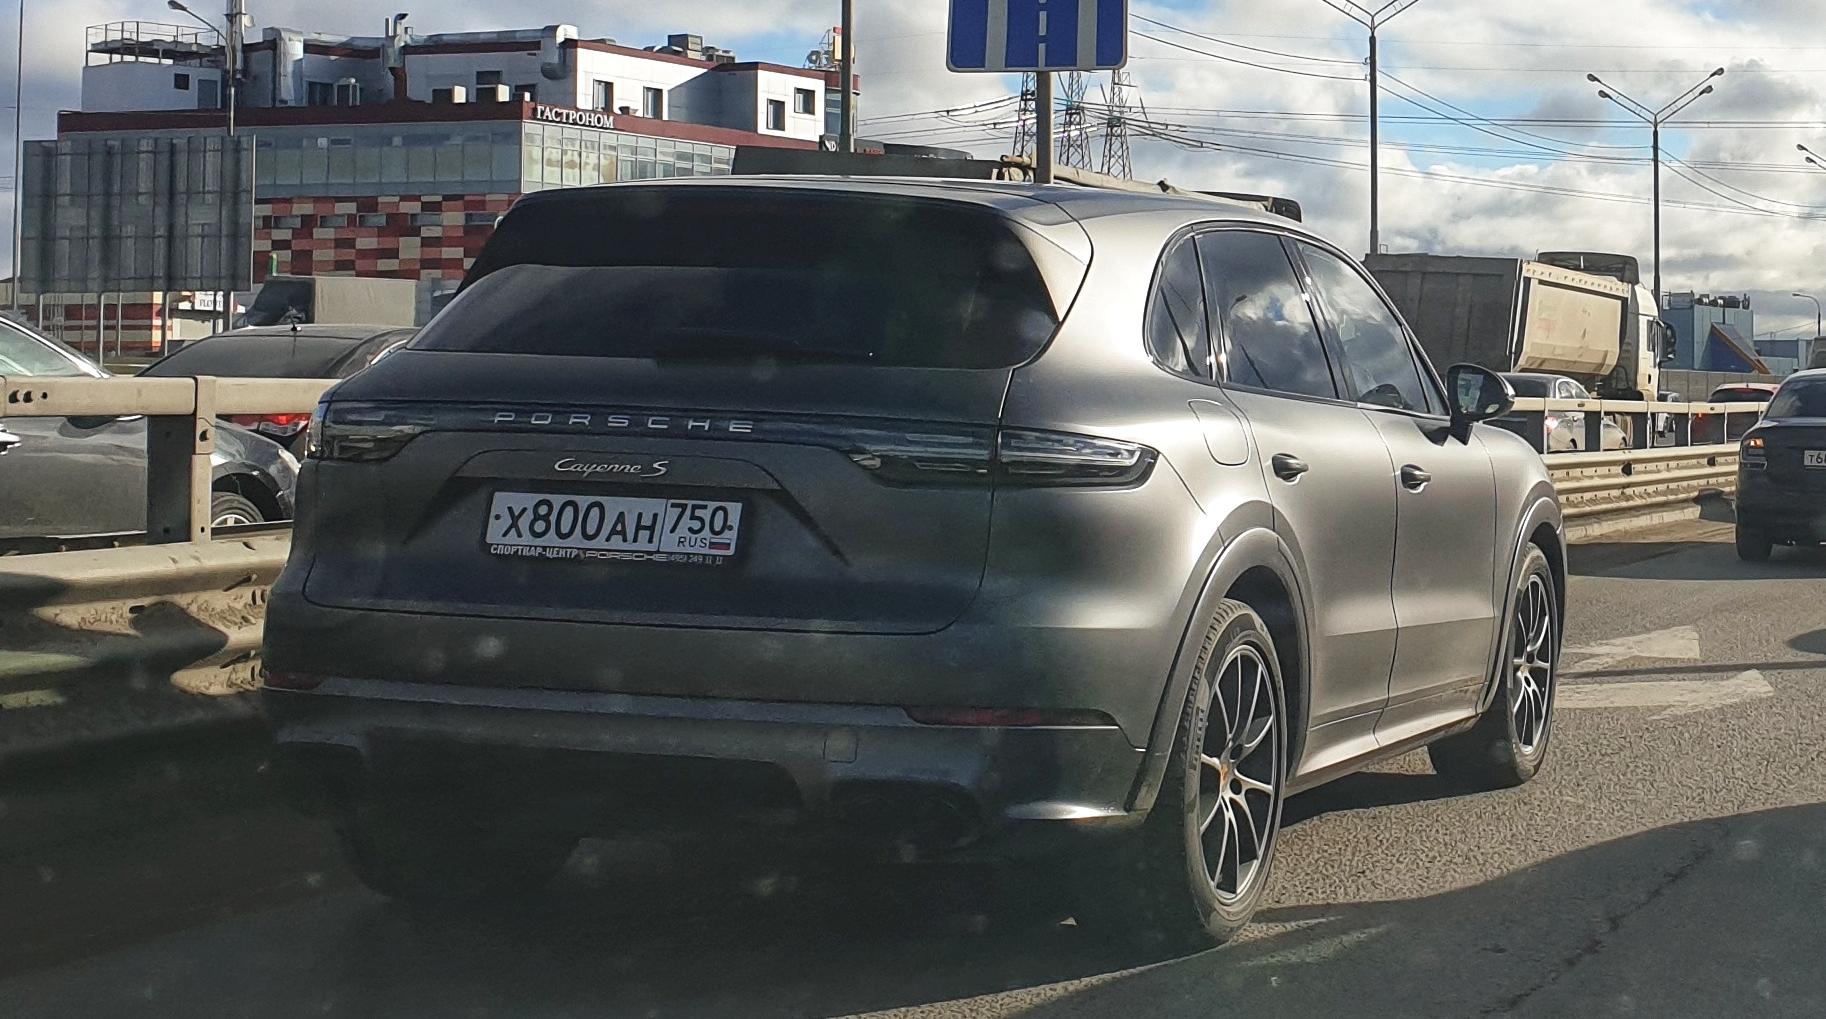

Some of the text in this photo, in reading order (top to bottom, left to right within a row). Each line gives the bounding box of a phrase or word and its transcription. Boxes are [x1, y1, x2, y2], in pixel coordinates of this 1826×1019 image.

[536, 105, 614, 128] ГАСТРОНОМ
[494, 412, 754, 433] PORSCHE
[554, 458, 670, 478] Cayenne S
[502, 498, 729, 544] Х800АН 750
[677, 537, 708, 549] RUS
[586, 550, 669, 562] PORSCHE
